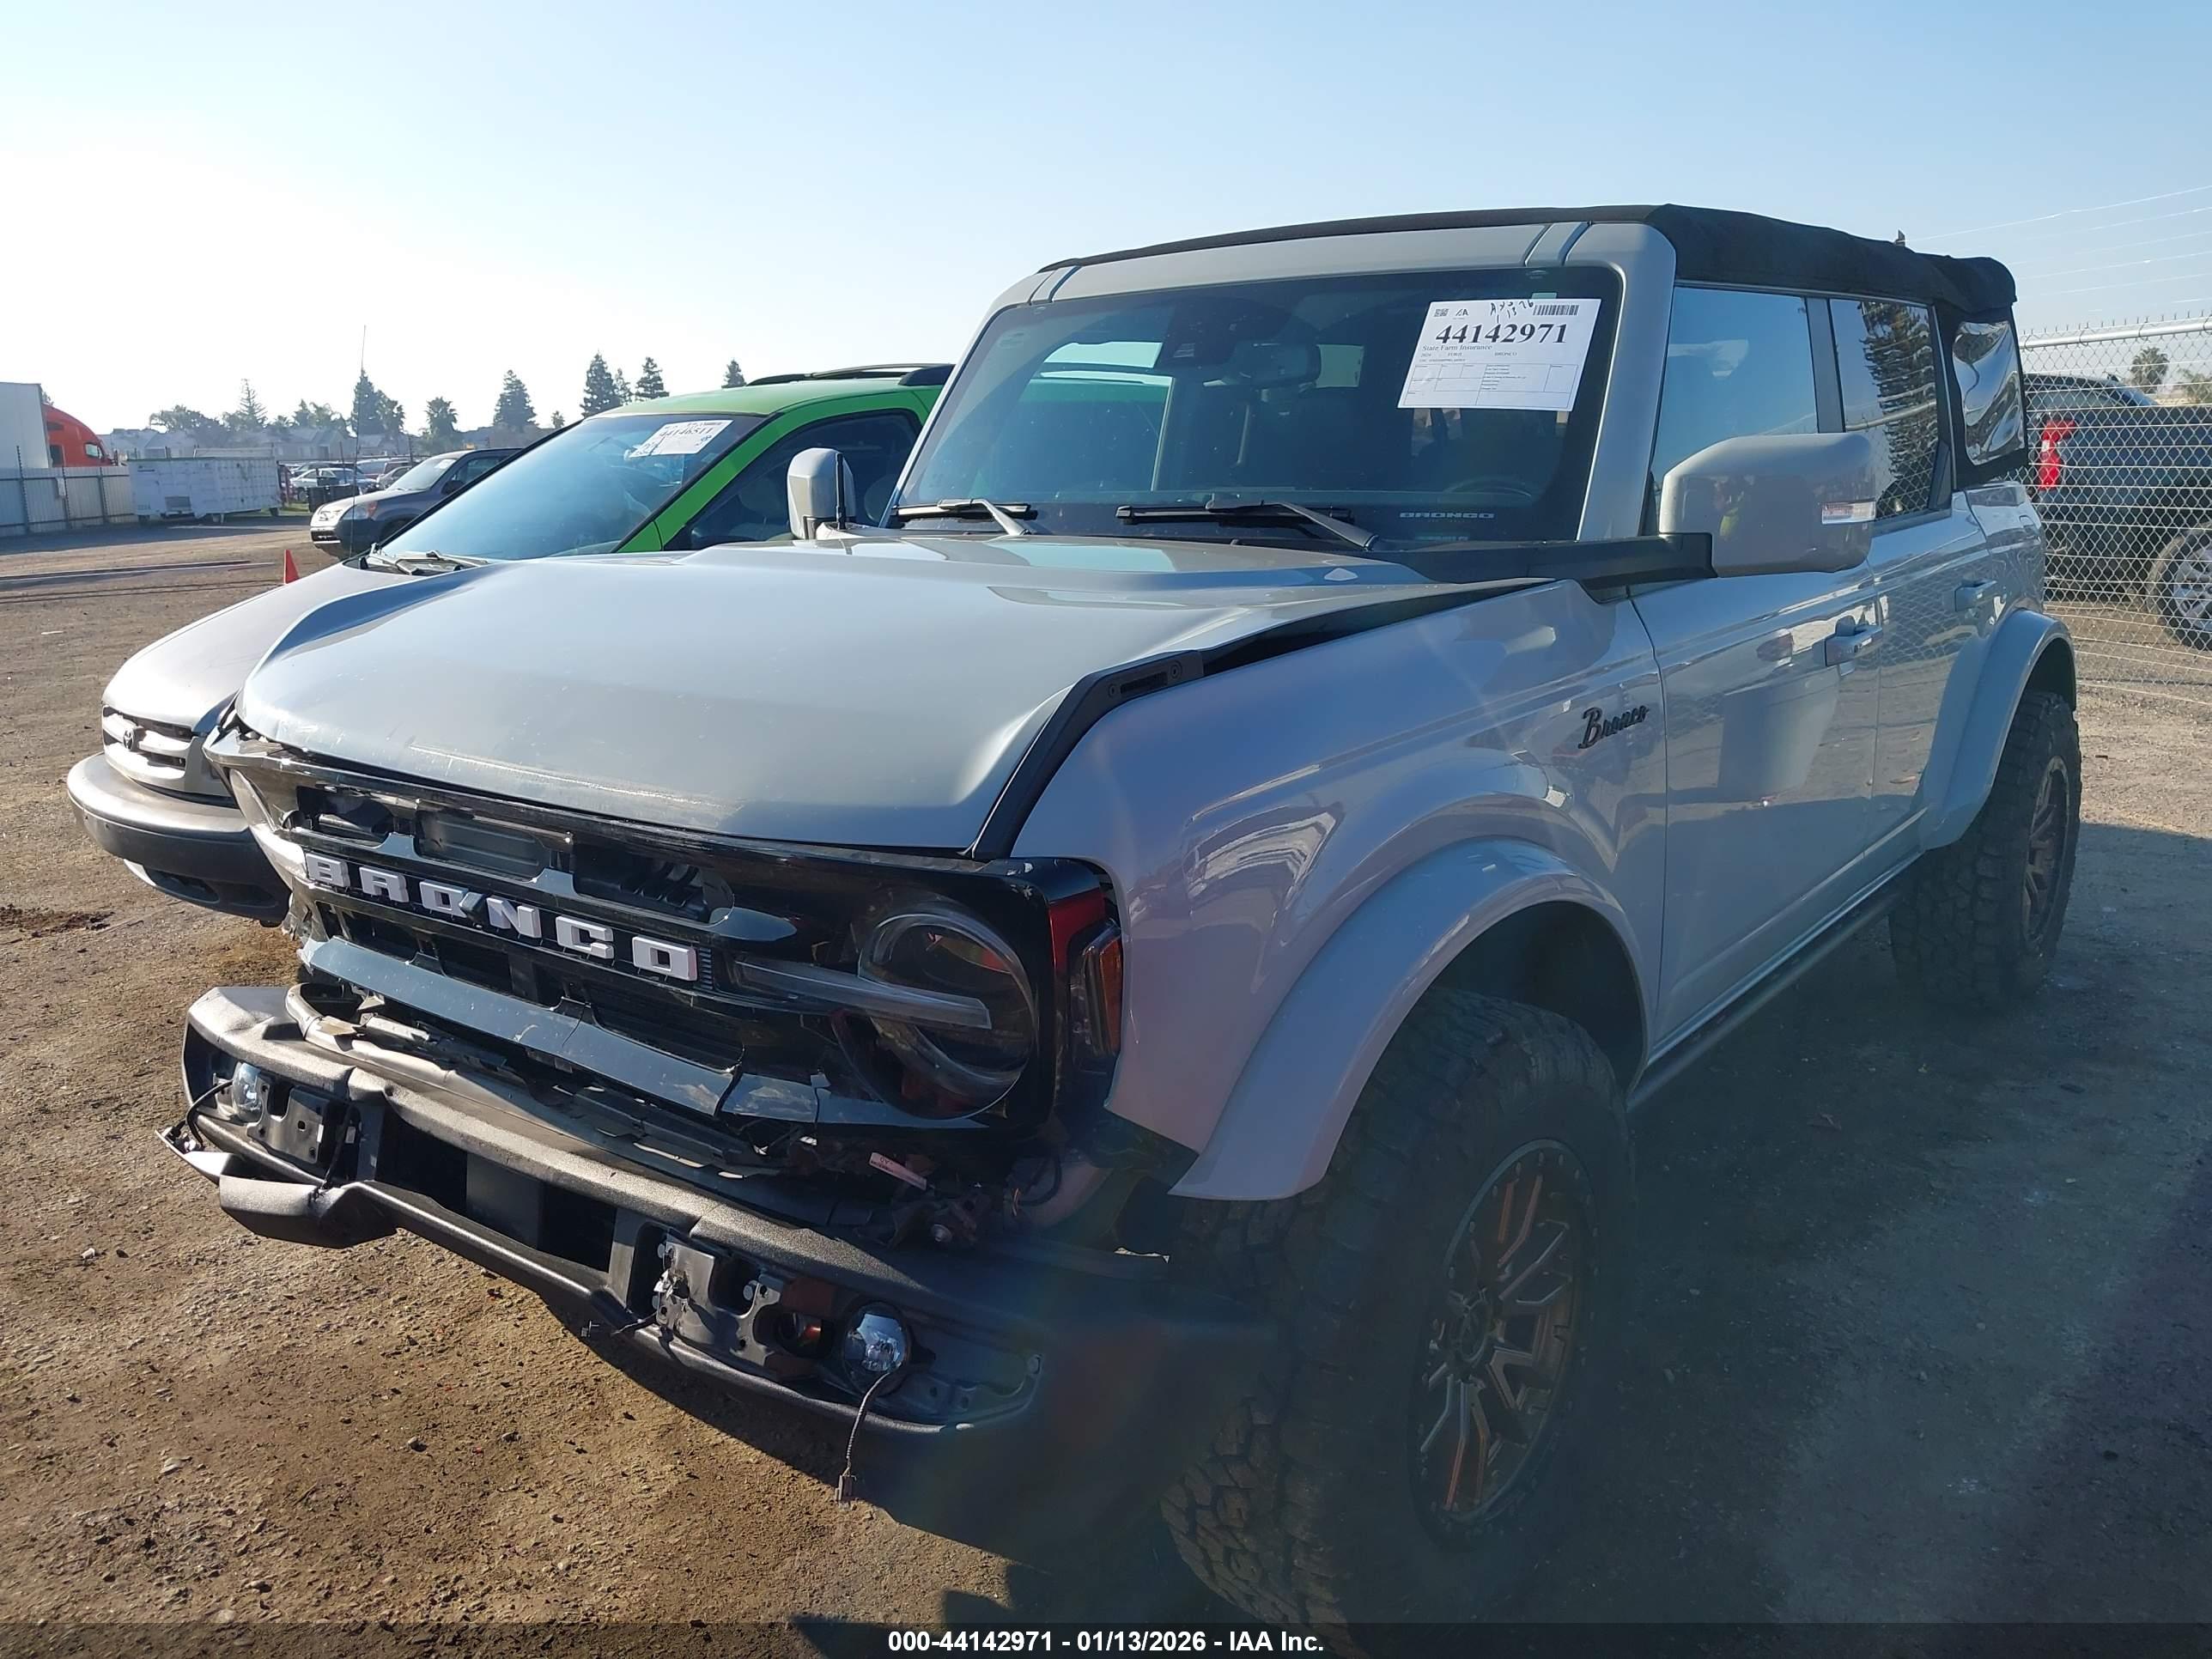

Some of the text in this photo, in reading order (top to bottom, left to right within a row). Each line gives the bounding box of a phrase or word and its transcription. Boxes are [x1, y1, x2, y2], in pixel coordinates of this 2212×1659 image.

[1435, 324, 1567, 343] 44142971
[1578, 705, 1650, 749] Bronco
[306, 853, 699, 981] BRONCO
